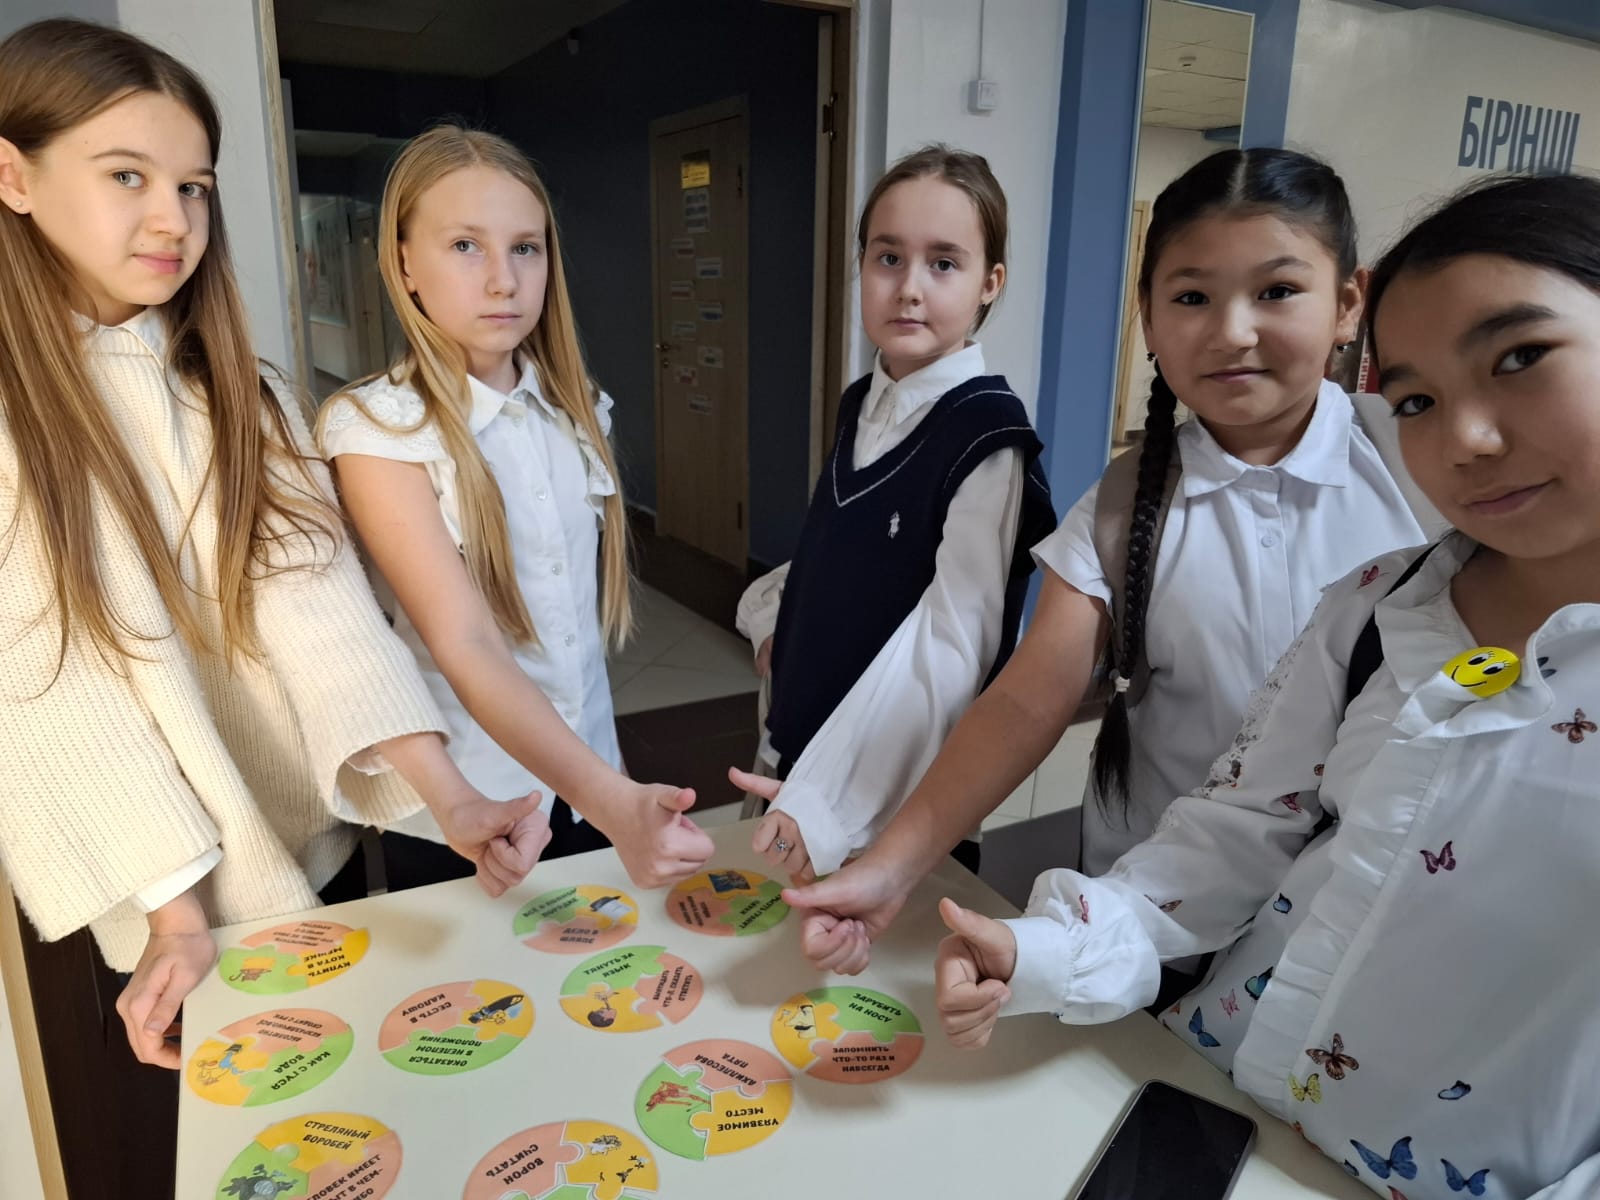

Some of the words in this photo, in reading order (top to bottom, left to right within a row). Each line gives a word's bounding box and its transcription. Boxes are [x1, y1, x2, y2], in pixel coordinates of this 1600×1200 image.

[1458, 95, 1581, 177] БІРІНШІ
[307, 961, 351, 977] КУПИТЬ
[320, 954, 346, 968] КОТА
[584, 957, 621, 975] ТЯНУТЬ
[621, 952, 635, 961] ЗА
[602, 962, 631, 978] ЯЗЫК
[402, 993, 446, 1016] КАЛОШУ
[419, 1001, 452, 1020] СЕСТЬ
[848, 1002, 864, 1012] НА
[863, 1008, 893, 1023] НОСУ
[852, 992, 902, 1016] ЗАРУБИТЬ
[307, 1051, 331, 1067] КАК
[415, 1045, 465, 1056] НЕЛЕПОМ
[832, 1055, 867, 1063] ЧТО-ТО
[274, 1054, 305, 1073] ВОДА
[409, 1055, 468, 1067] ОКАЗАТЬСЯ
[694, 1054, 757, 1086] АХИЛЛЕСОВА
[721, 1053, 749, 1068] ПЯТА
[842, 1064, 890, 1073] НАВСЕГДА
[271, 1071, 300, 1090] ГУСЯ
[725, 1106, 764, 1117] МЕСТО
[304, 1120, 372, 1140] СТРЕЛЯНЫЙ
[717, 1118, 779, 1132] УЯЗВИМОЕ
[302, 1134, 353, 1151] ВОРОБЕЙ
[347, 1153, 381, 1178] ИМЕЕТ
[485, 1143, 540, 1178] СЧИТАТЬ
[347, 1184, 356, 1192] В
[356, 1168, 383, 1185] ЧЕМ-
[502, 1157, 545, 1185] ВОРОН
